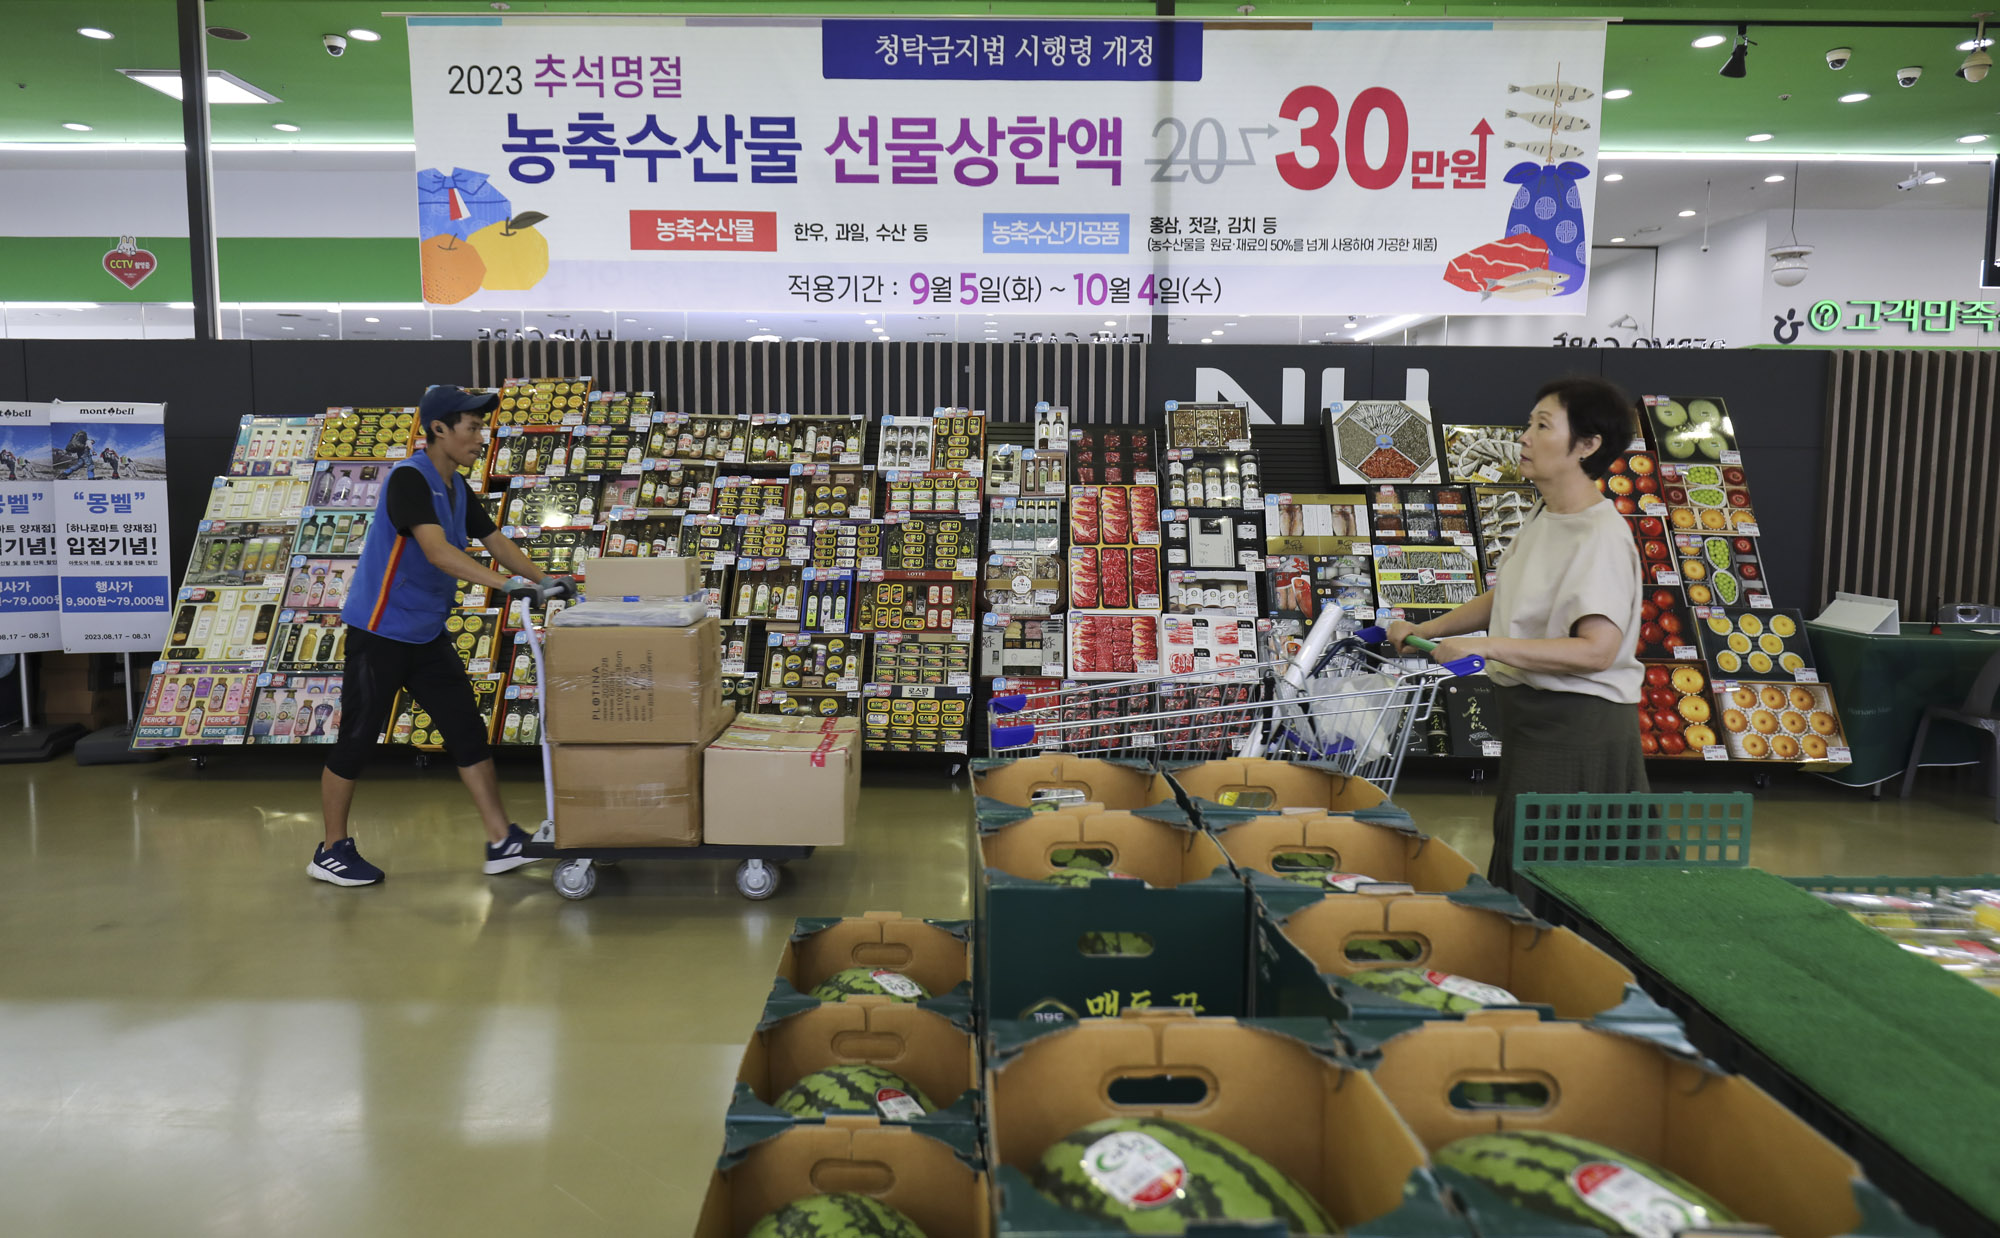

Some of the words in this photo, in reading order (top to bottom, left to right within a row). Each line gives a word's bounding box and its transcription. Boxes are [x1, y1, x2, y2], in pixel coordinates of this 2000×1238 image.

[875, 34, 1004, 66] 청탁금지법
[1015, 35, 1091, 67] 시행령
[1103, 35, 1152, 67] 개정
[448, 65, 522, 95] 2023
[534, 54, 682, 98] 추석명절
[502, 112, 802, 184] 농축수산물
[824, 115, 1122, 187] 선물상한액
[1151, 117, 1227, 185] 20
[655, 217, 755, 243] 농축수산물
[794, 222, 828, 242] 한우,
[835, 223, 868, 242] 과일,
[876, 224, 907, 241] 수산
[913, 224, 928, 242] 등
[991, 221, 1120, 246] 농축수산가공품
[1150, 216, 1182, 234] 홍삼,
[1189, 216, 1220, 234] 젓갈,
[1228, 216, 1256, 234] 김치
[1263, 216, 1278, 234] 등
[1148, 237, 1205, 252] (농수산물을
[1271, 237, 1304, 252] 50%를
[1307, 237, 1328, 252] 넘게
[1332, 237, 1374, 252] 사용하여
[1377, 237, 1409, 252] 가공한
[1412, 237, 1437, 252] 제품)
[110, 260, 133, 268] CCTV
[788, 275, 884, 303] 적용기간
[910, 272, 952, 305] 9월
[960, 272, 1042, 305] 5일(화)
[1073, 272, 1131, 306] 10월
[1138, 273, 1222, 306] 4일(수)
[1844, 300, 2000, 333] 고객만족
[20, 524, 56, 534] 양재점]
[66, 524, 118, 533] [하나로마트
[123, 524, 157, 533] 양재점]
[66, 536, 157, 556] 입점기념!
[96, 581, 134, 593] 행사가
[908, 688, 929, 696] 로스팜
